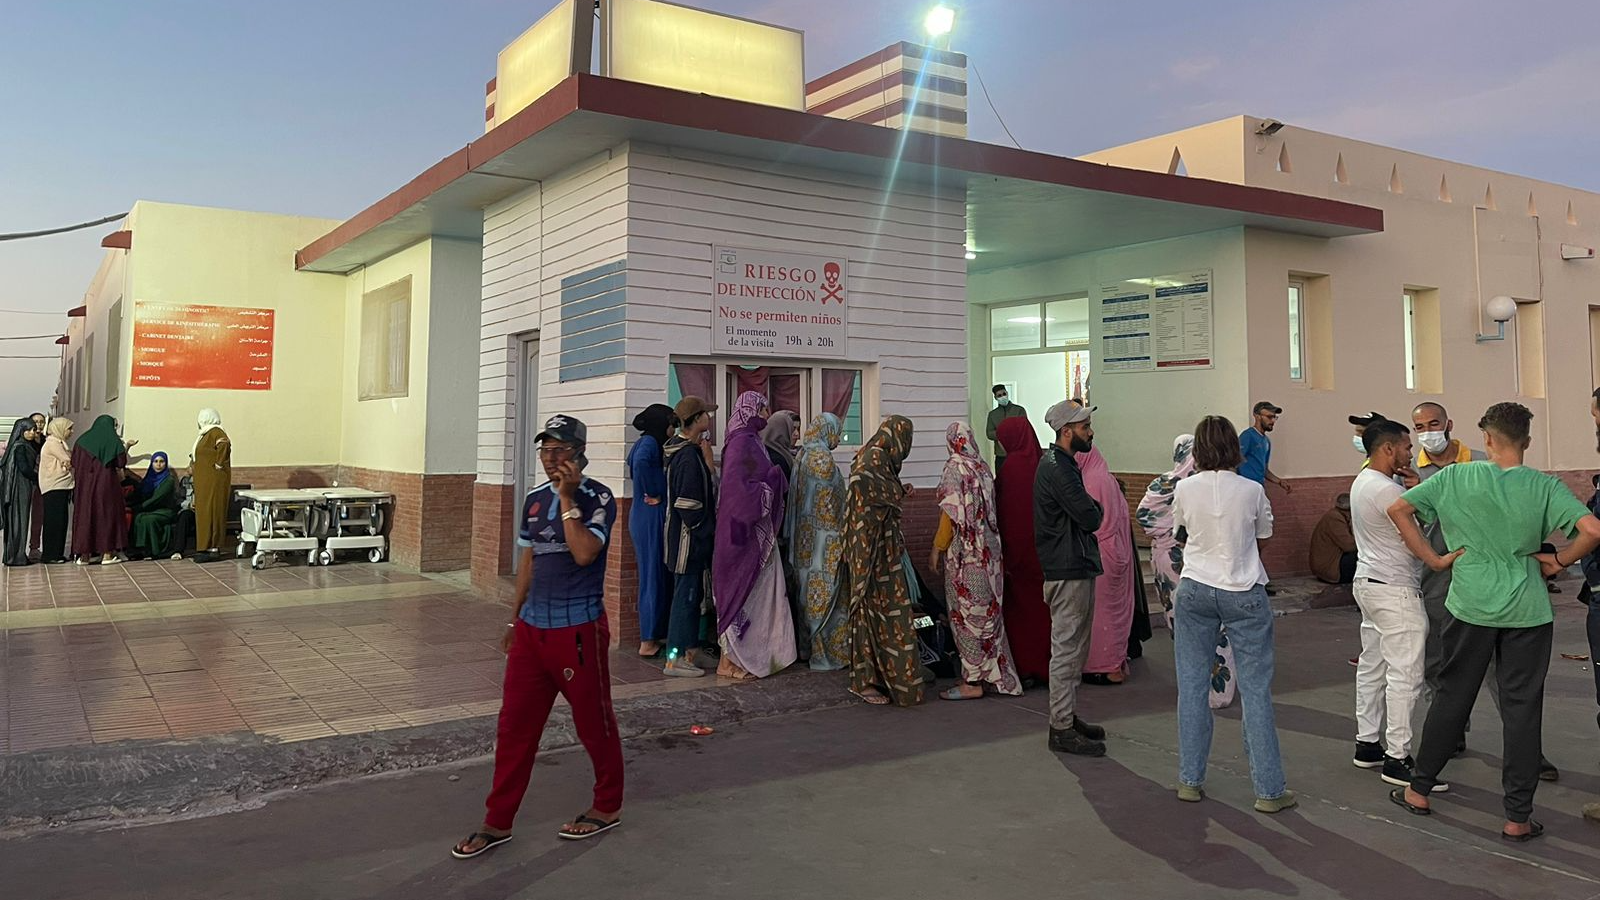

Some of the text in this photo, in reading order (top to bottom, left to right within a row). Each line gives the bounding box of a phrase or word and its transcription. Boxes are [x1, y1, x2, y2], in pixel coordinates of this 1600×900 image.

[744, 263, 817, 283] RIESGO
[717, 283, 816, 302] DE INFECCIÓN
[719, 306, 842, 325] No se permiten niños
[725, 326, 777, 337] El momento
[728, 337, 774, 348] de la visita
[785, 335, 834, 347] 19h à 20h
